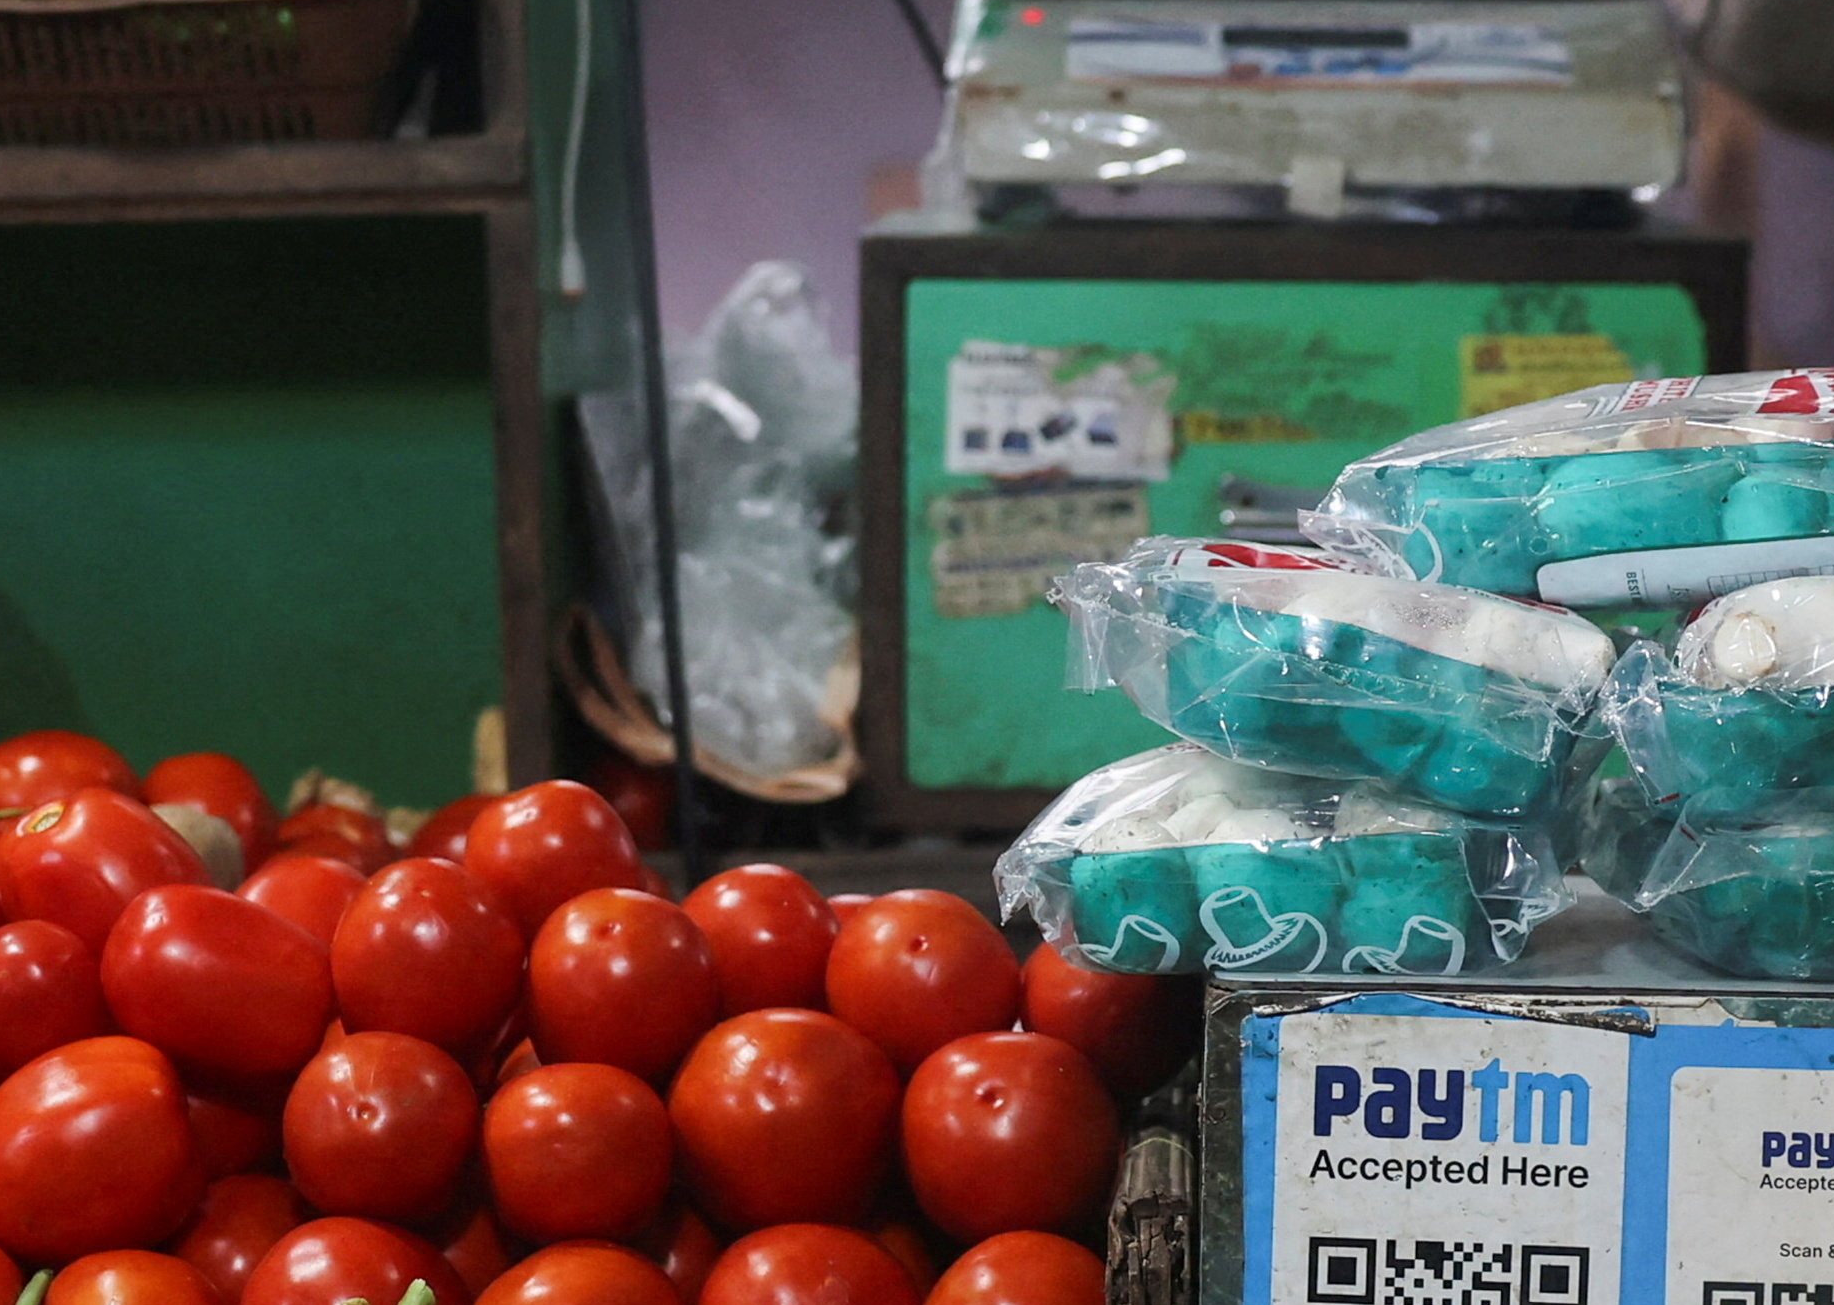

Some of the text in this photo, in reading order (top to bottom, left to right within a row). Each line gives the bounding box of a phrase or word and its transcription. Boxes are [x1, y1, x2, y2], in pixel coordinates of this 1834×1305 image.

[1309, 1149, 1590, 1190] Accepted Here
[1779, 1243, 1823, 1258] Scan
